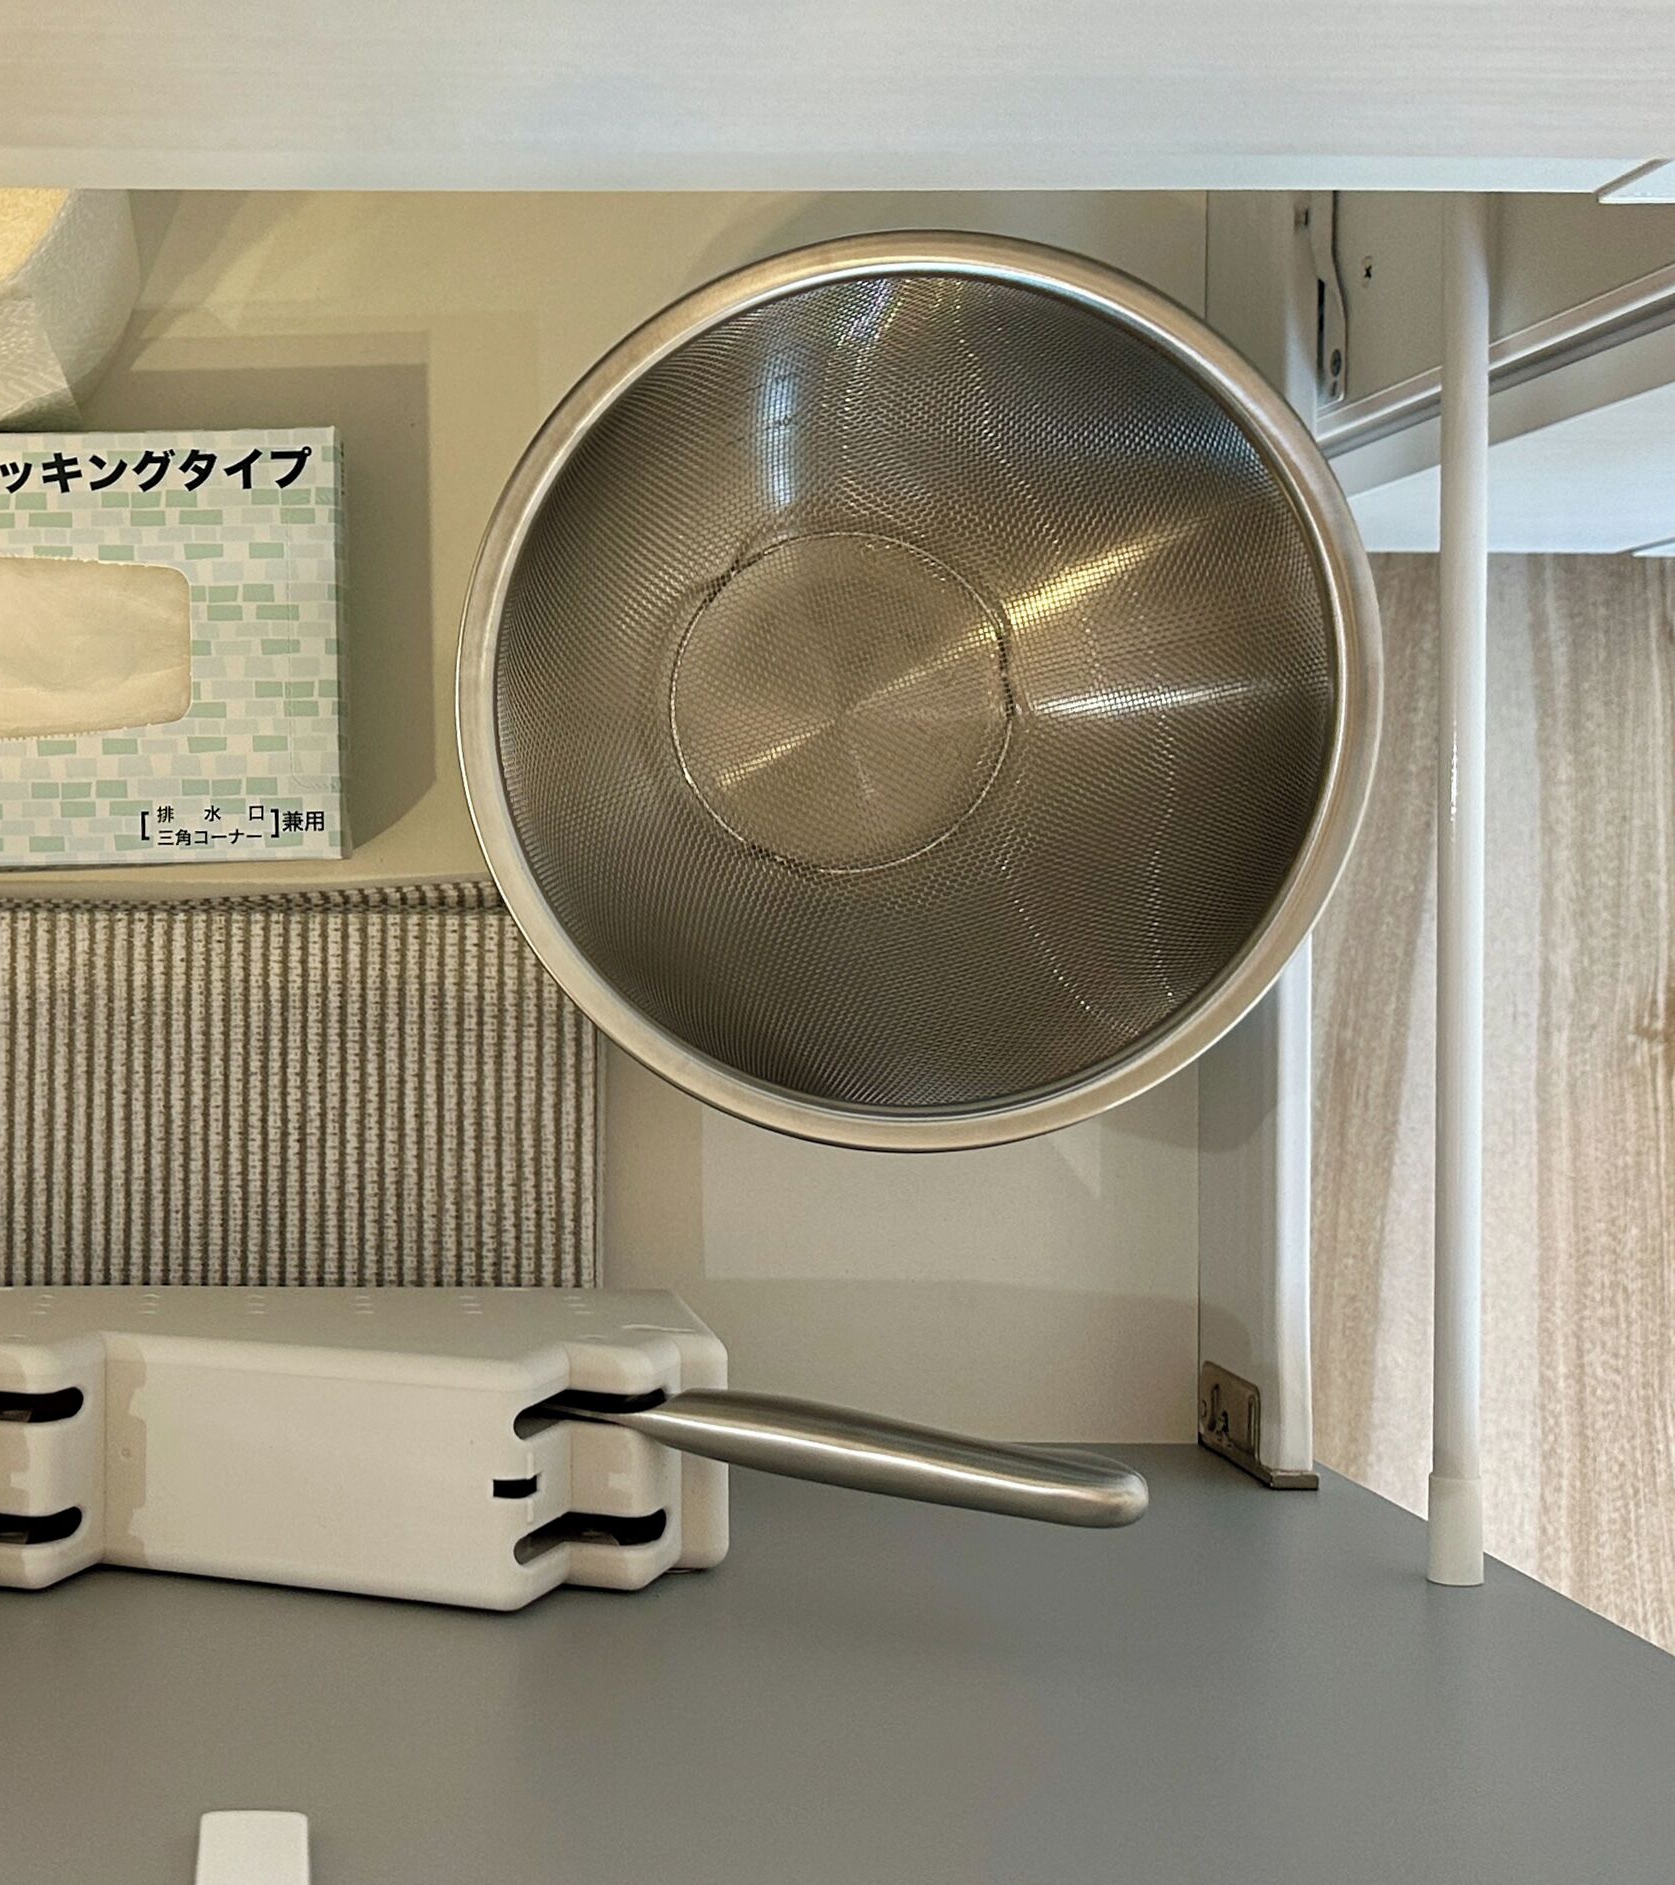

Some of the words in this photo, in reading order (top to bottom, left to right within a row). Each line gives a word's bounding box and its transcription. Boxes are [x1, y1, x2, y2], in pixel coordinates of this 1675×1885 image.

[157, 829, 262, 846] 三角コーナー
